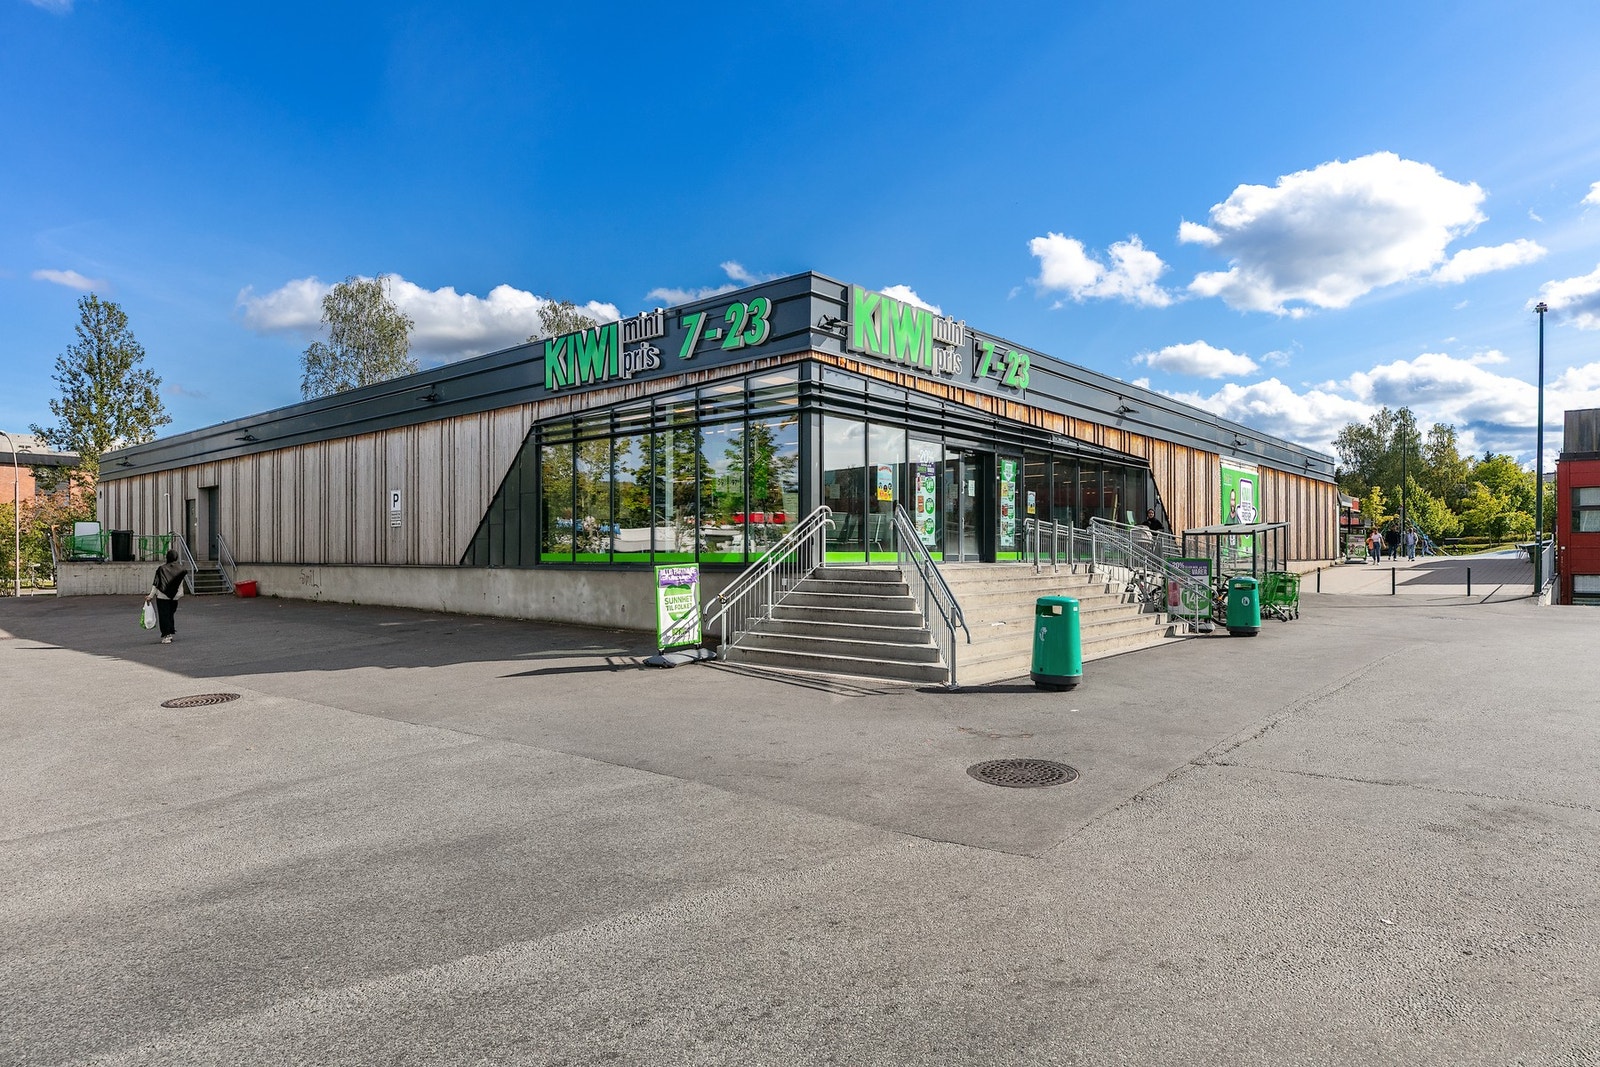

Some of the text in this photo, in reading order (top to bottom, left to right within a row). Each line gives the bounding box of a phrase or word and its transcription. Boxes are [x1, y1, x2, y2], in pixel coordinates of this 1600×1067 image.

[621, 308, 664, 343] mini
[679, 297, 772, 360] 7-23
[848, 284, 933, 370] KIWI
[932, 315, 965, 348] mini
[544, 322, 623, 391] KIWI
[621, 342, 661, 379] pris
[932, 347, 964, 377] pris
[975, 340, 1030, 390] 7-23
[393, 493, 399, 508] P
[664, 596, 693, 605] SUNNHET
